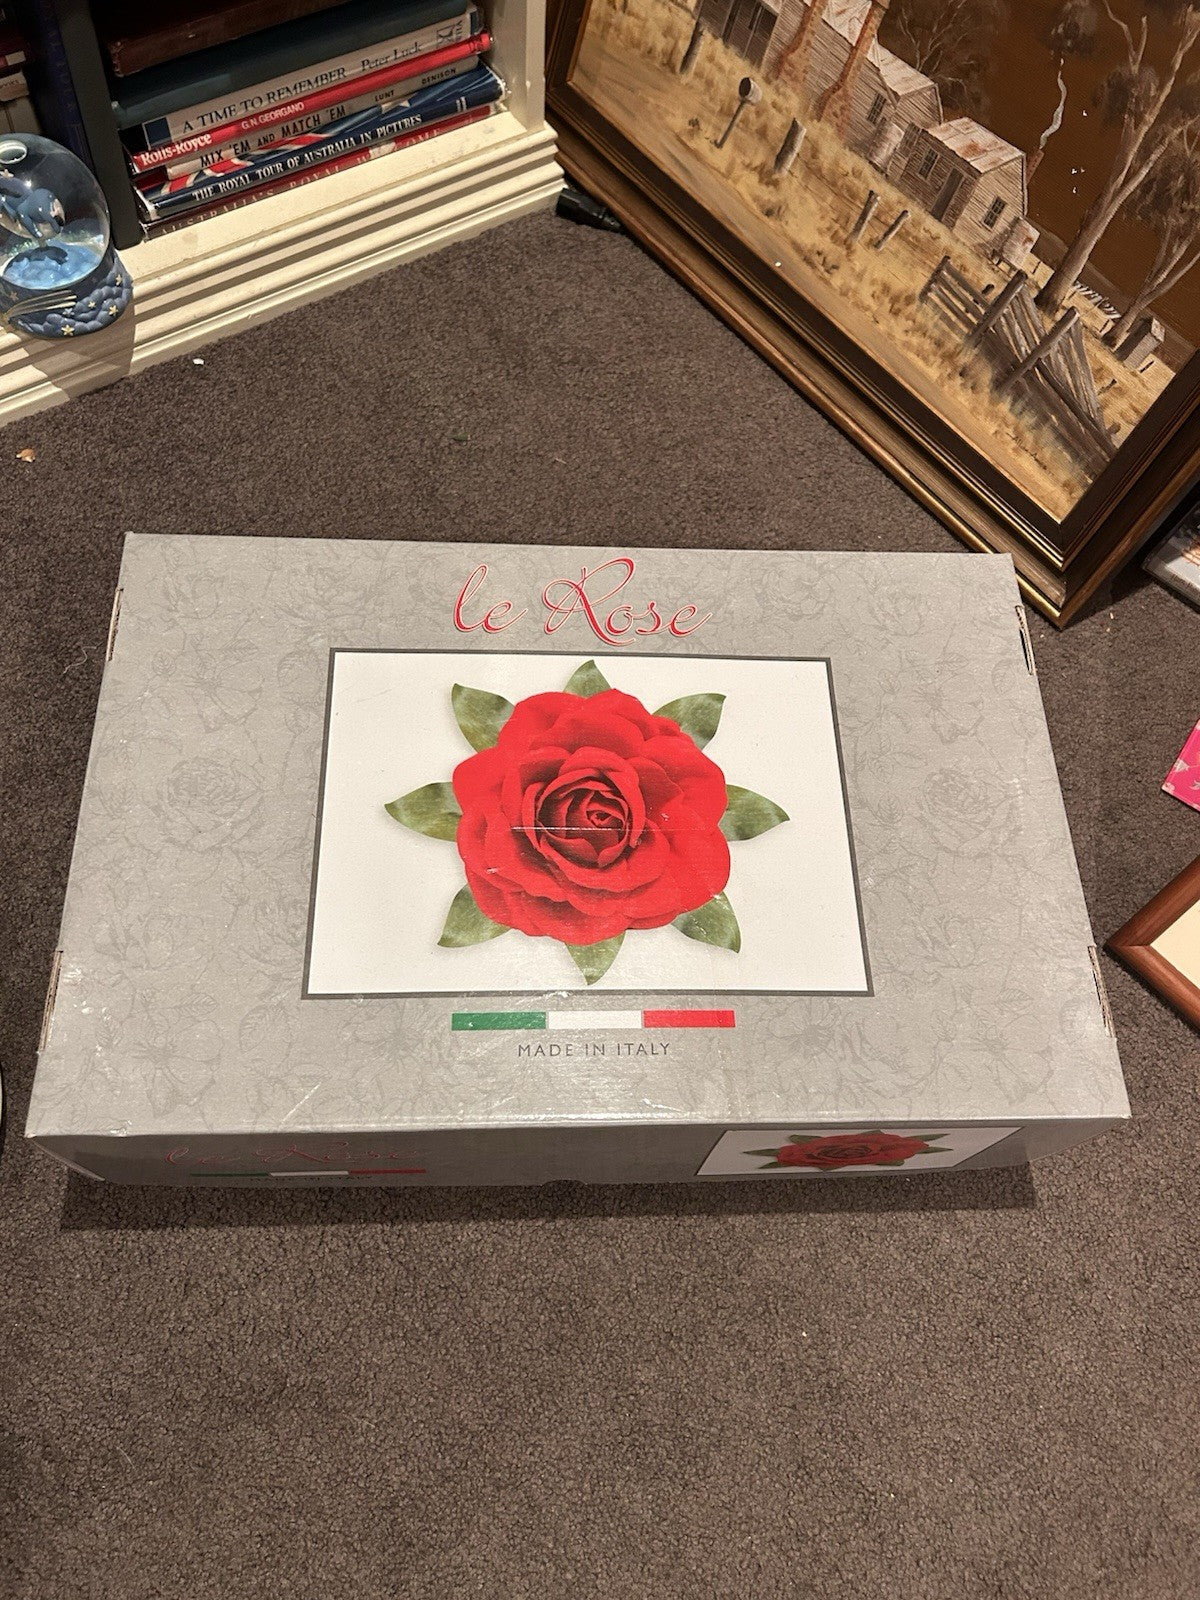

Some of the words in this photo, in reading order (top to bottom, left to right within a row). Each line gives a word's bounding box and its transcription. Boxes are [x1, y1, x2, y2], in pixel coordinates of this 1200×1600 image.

[361, 54, 390, 71] Peter
[393, 42, 421, 60] Luck
[374, 90, 394, 101] LUNT
[421, 67, 456, 85] DENISON
[182, 120, 194, 133] A
[197, 104, 238, 127] TIME
[240, 94, 263, 111] TO
[266, 67, 348, 102] REMEMBER
[192, 188, 214, 202] THE
[218, 174, 250, 193] ROYAL
[256, 163, 284, 179] TOUR
[287, 156, 300, 169] OF
[303, 136, 356, 166] AUSTRALIA
[360, 131, 372, 144] IN
[377, 114, 423, 136] PICTURES
[200, 150, 224, 168] MIX
[229, 140, 251, 156] 'EM
[257, 133, 276, 147] AND
[281, 114, 321, 137] MATCH
[327, 105, 346, 121] 'EM
[454, 563, 528, 634] le
[542, 556, 714, 647] Rose
[518, 1043, 573, 1057] MADE
[585, 1043, 606, 1056] IN
[617, 1042, 672, 1056] ITALY
